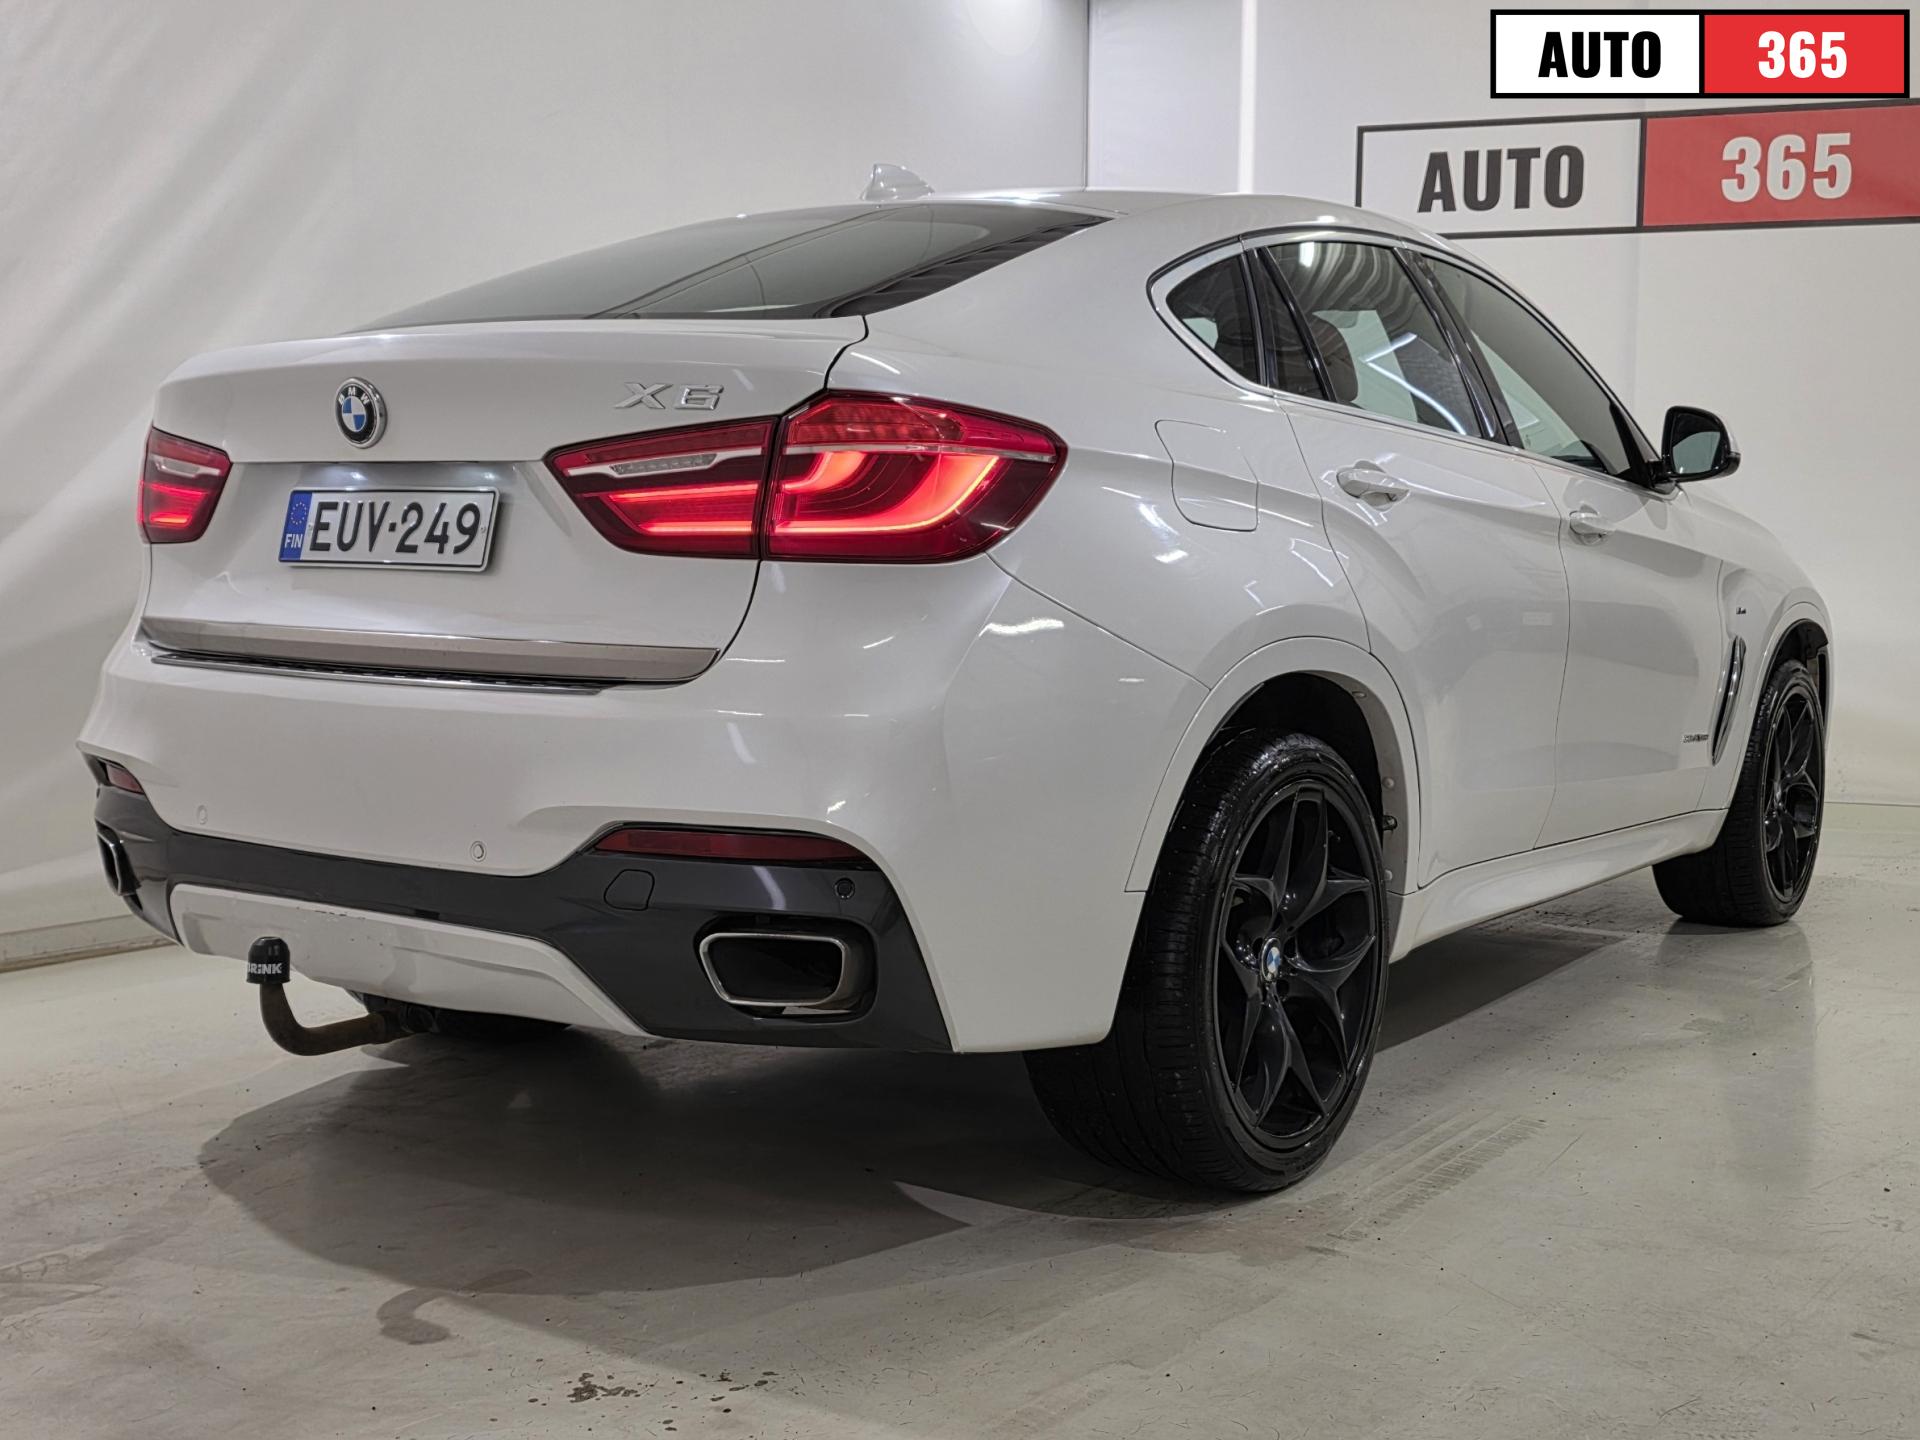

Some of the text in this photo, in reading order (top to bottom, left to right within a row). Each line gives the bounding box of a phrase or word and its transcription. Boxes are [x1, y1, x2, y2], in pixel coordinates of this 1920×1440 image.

[1417, 132, 1852, 213] AUTO 365
[338, 386, 370, 406] BMW
[613, 382, 724, 410] X6
[284, 533, 303, 548] FIN
